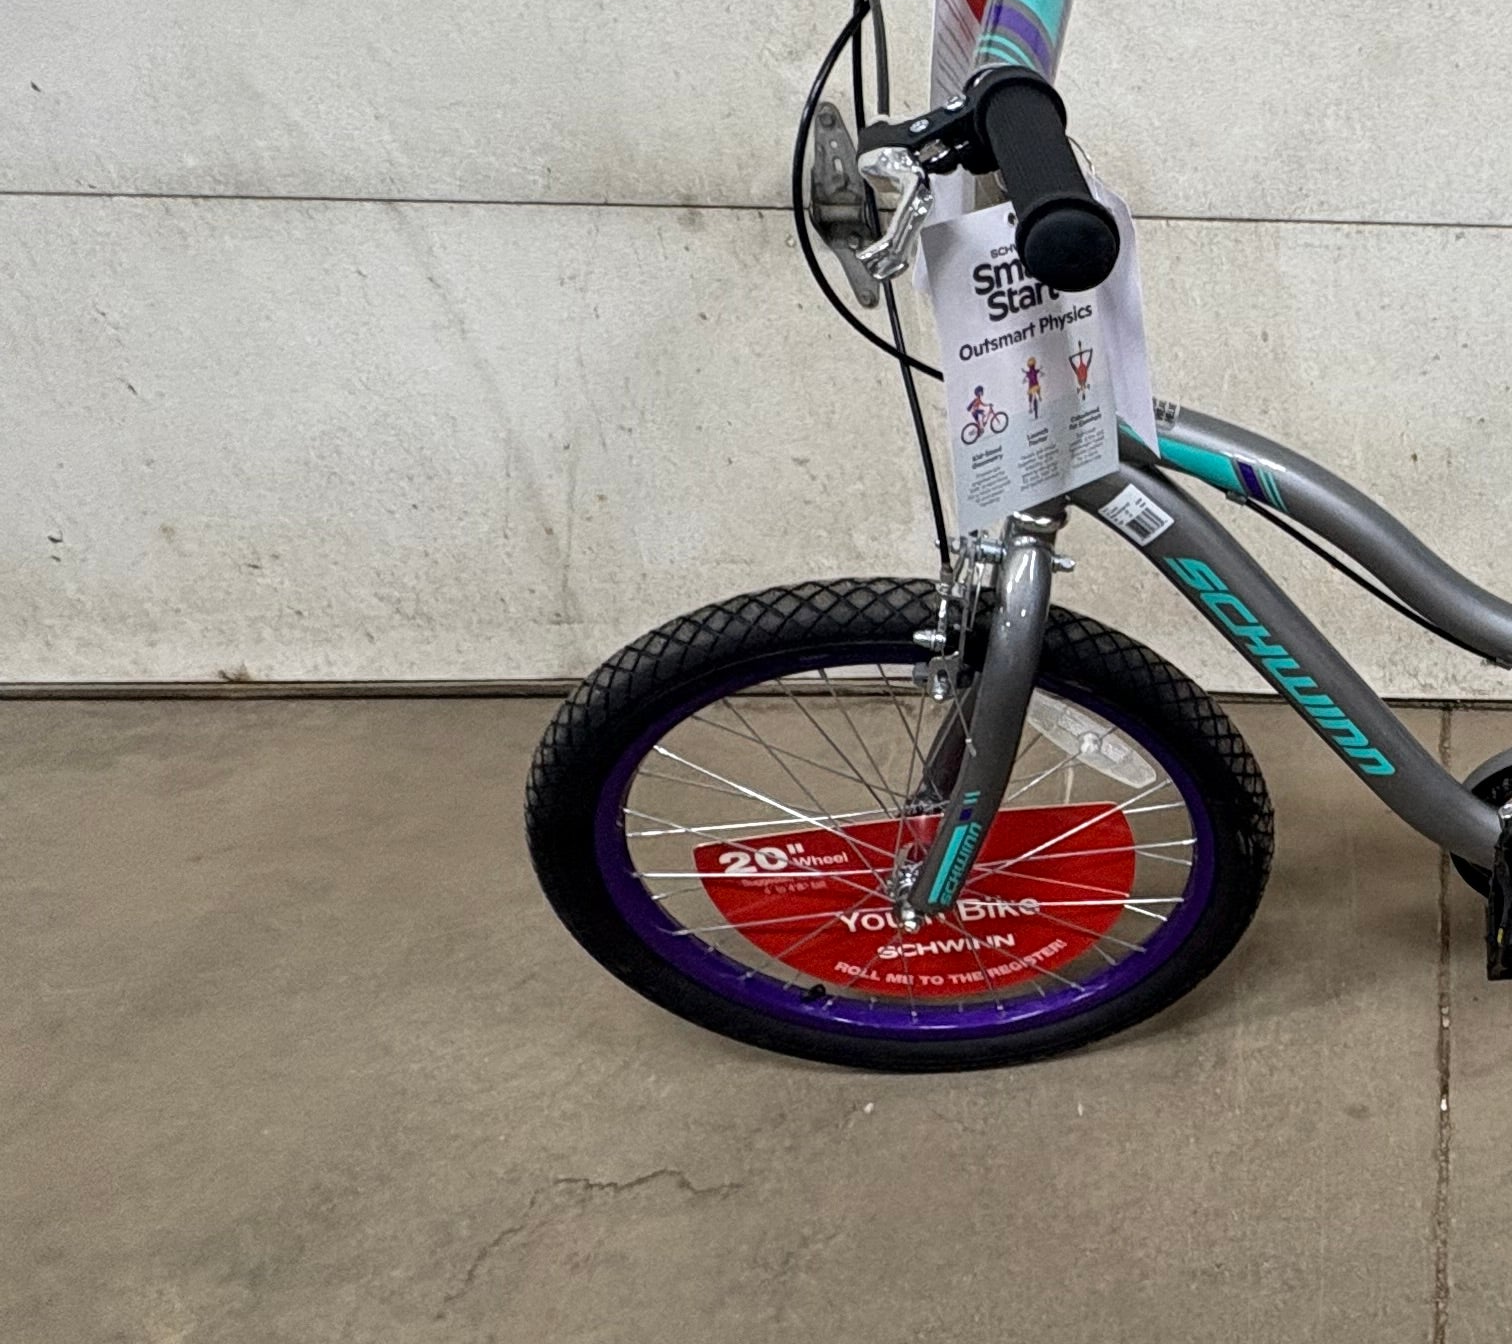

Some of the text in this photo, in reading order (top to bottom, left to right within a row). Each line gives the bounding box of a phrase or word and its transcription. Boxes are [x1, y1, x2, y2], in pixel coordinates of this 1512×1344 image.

[959, 305, 1093, 361] Outsmart Physics
[1163, 557, 1396, 775] SCHWINN
[790, 851, 850, 867] Wheel
[939, 821, 982, 905] SCHWINN
[956, 898, 1041, 922] Bike
[834, 938, 1068, 986] ROLL ME TO THE REGISTER!
[876, 933, 1016, 960] SCHWINN
